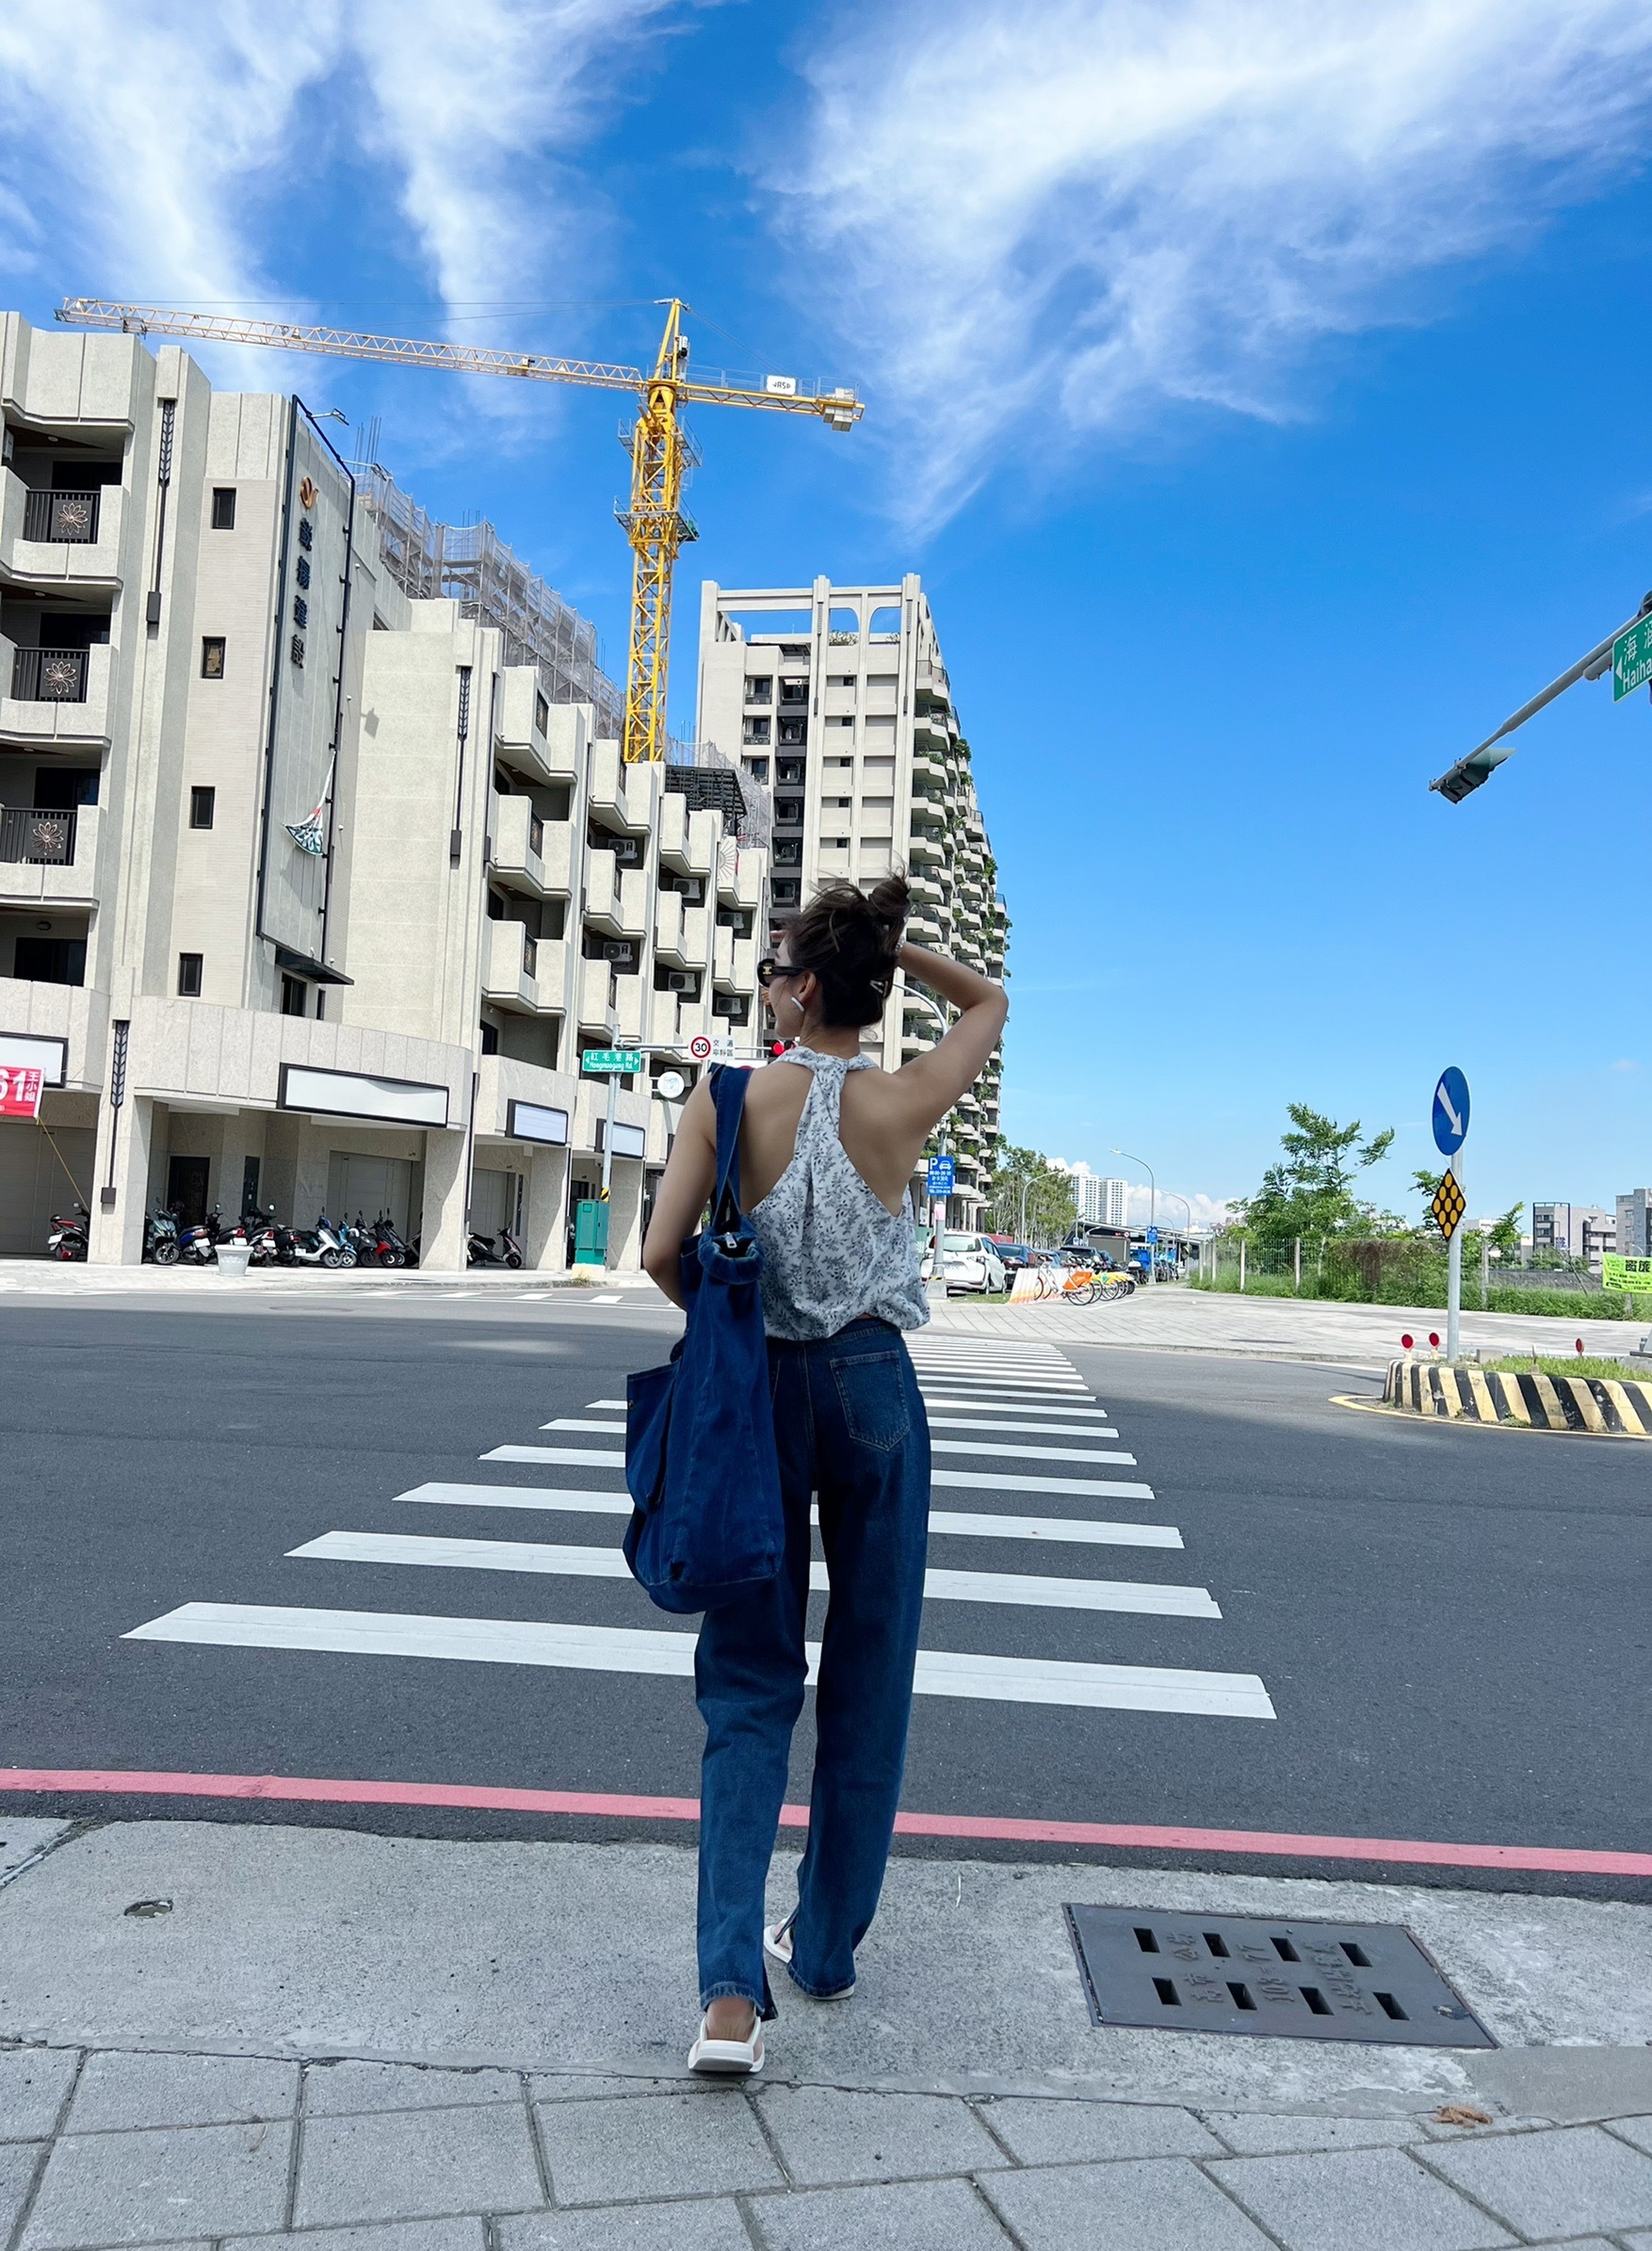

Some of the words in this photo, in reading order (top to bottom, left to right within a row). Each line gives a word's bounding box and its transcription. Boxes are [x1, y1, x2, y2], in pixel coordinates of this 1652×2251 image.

[694, 1043, 707, 1053] 30
[24, 1071, 40, 1102] 王小姐
[930, 1158, 938, 1170] P
